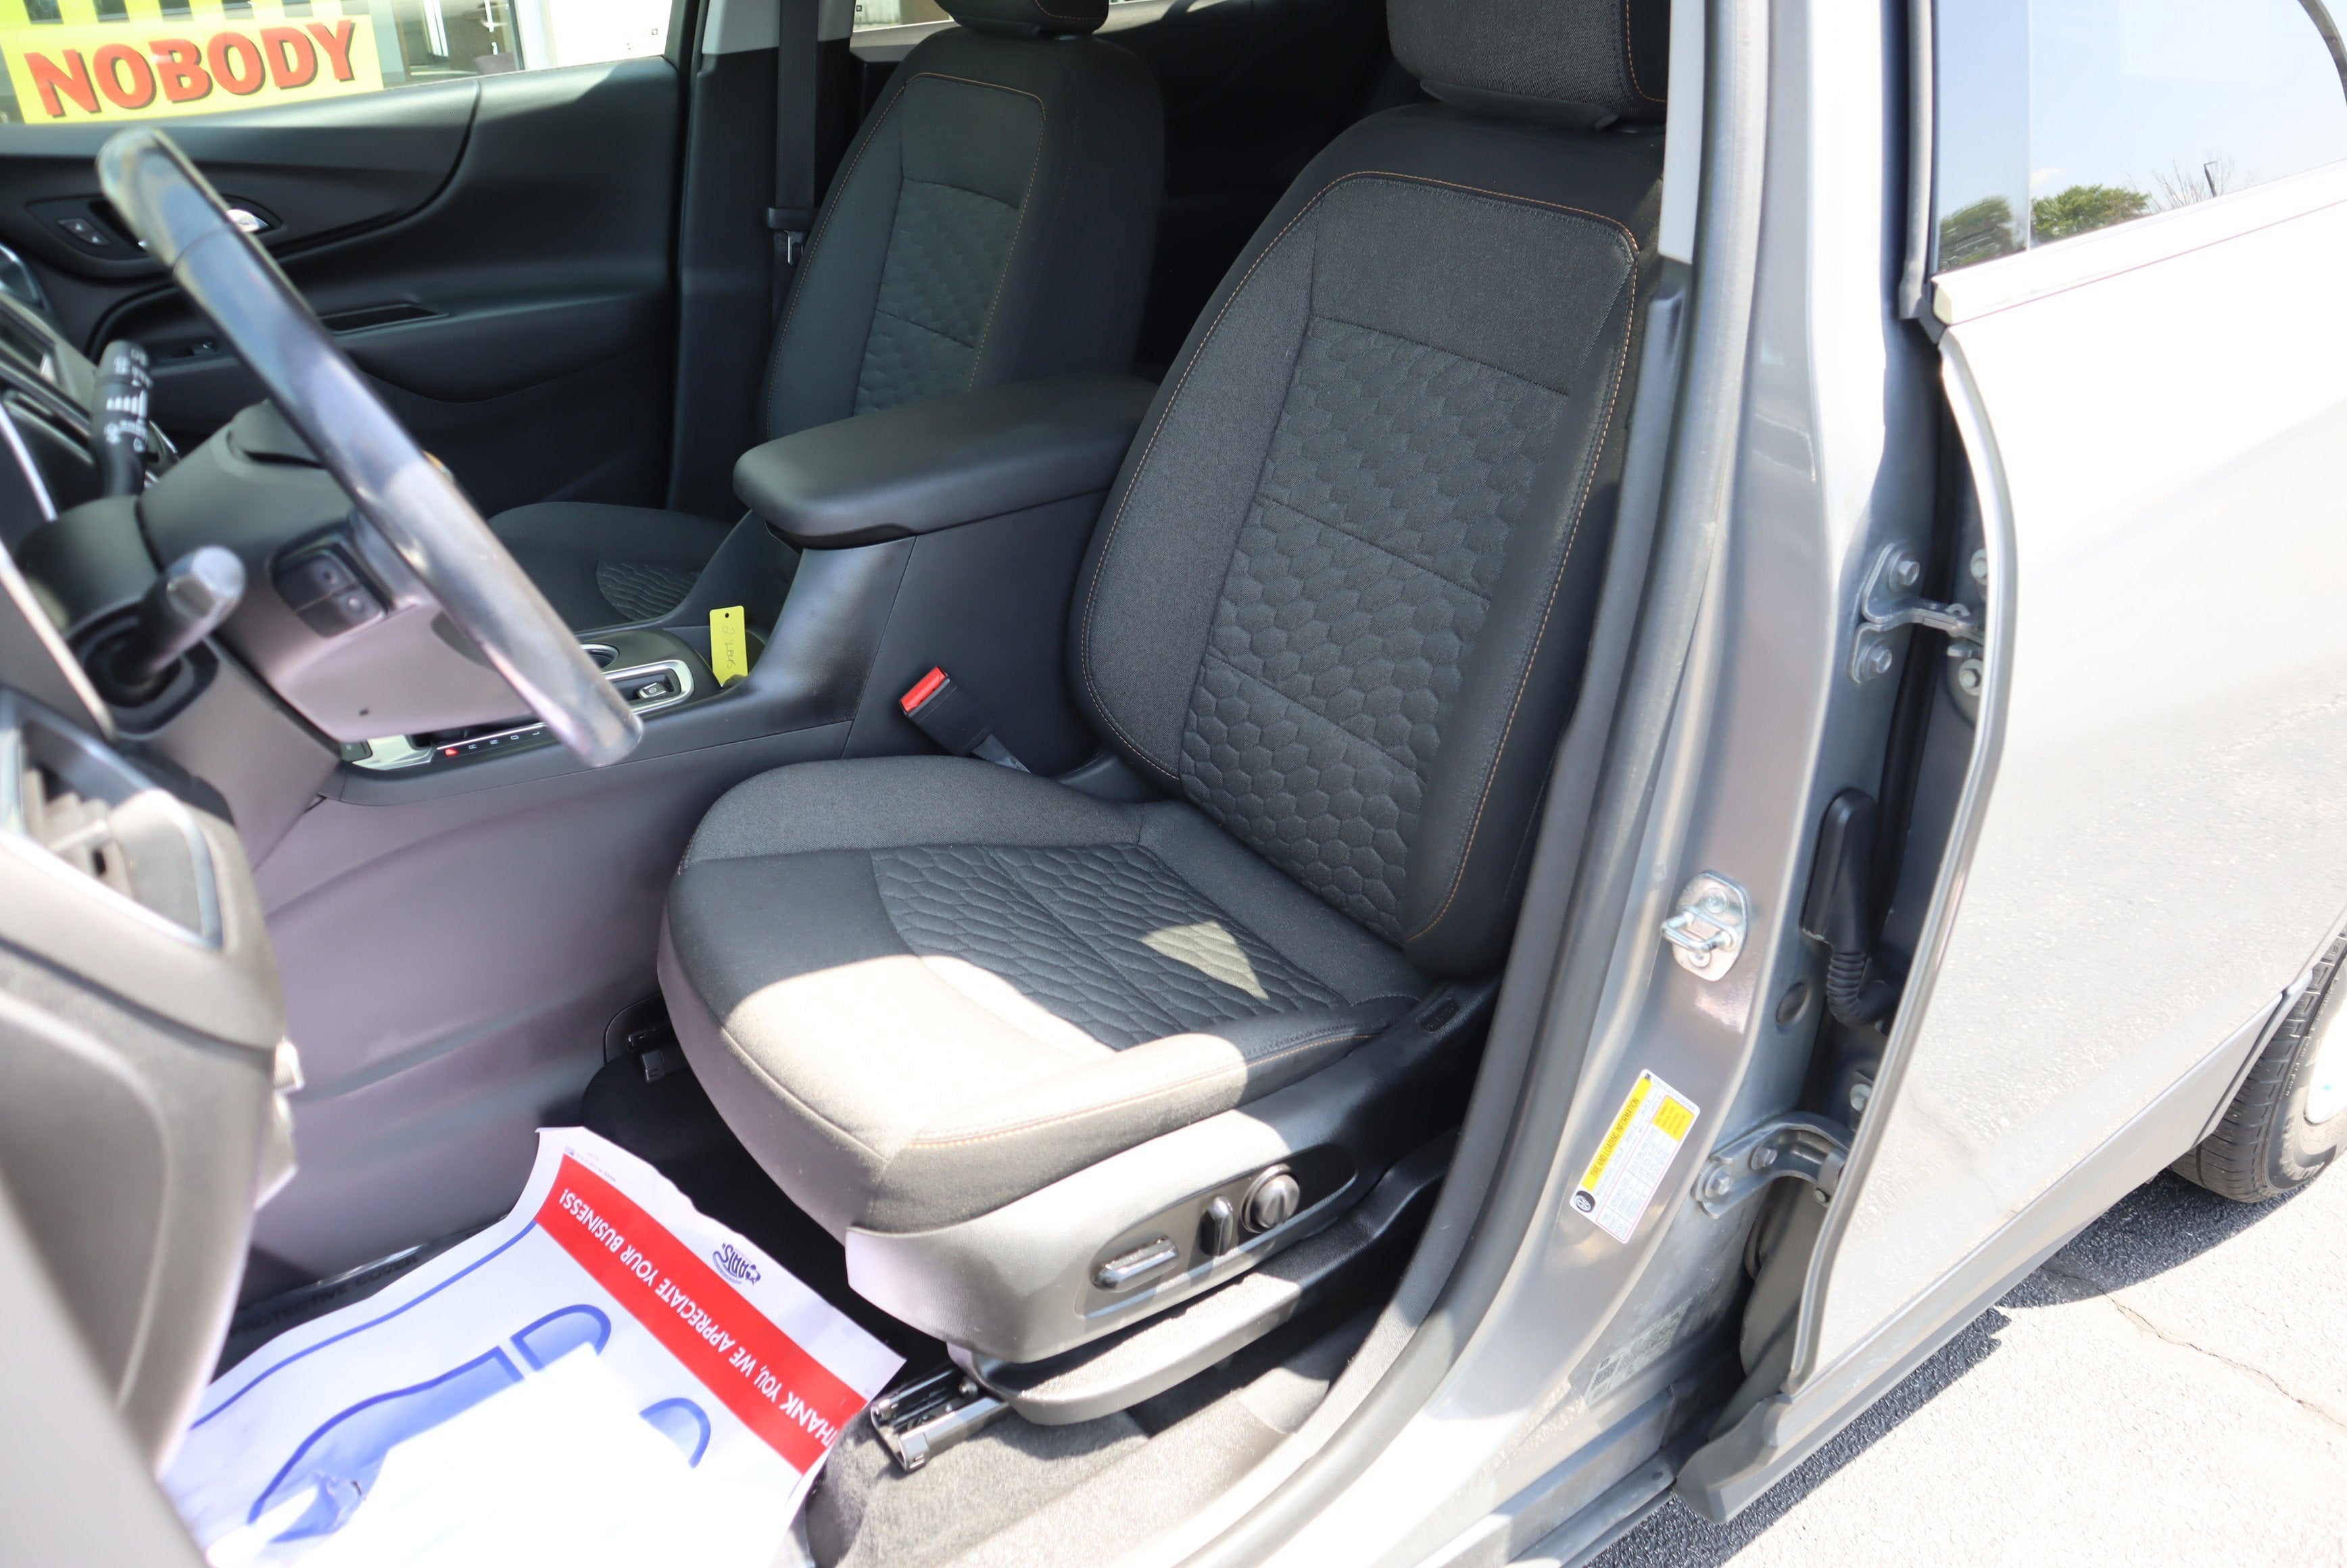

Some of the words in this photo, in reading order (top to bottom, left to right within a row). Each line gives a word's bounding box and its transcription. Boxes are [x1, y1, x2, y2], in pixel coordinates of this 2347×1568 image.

[24, 19, 356, 118] NOBODY
[722, 626, 735, 635] 2
[1589, 1165, 1601, 1177] TIRE
[1595, 1153, 1607, 1167] AND
[1601, 1131, 1620, 1156] LOADING
[1614, 1096, 1639, 1133] INFORMATION
[558, 1188, 625, 1254] BUSINESS!
[619, 1244, 660, 1288] YOUR
[654, 1277, 737, 1353] APPRECIATE
[728, 1346, 757, 1378] WE
[752, 1365, 783, 1404] YOU,
[779, 1391, 838, 1448] THANK
